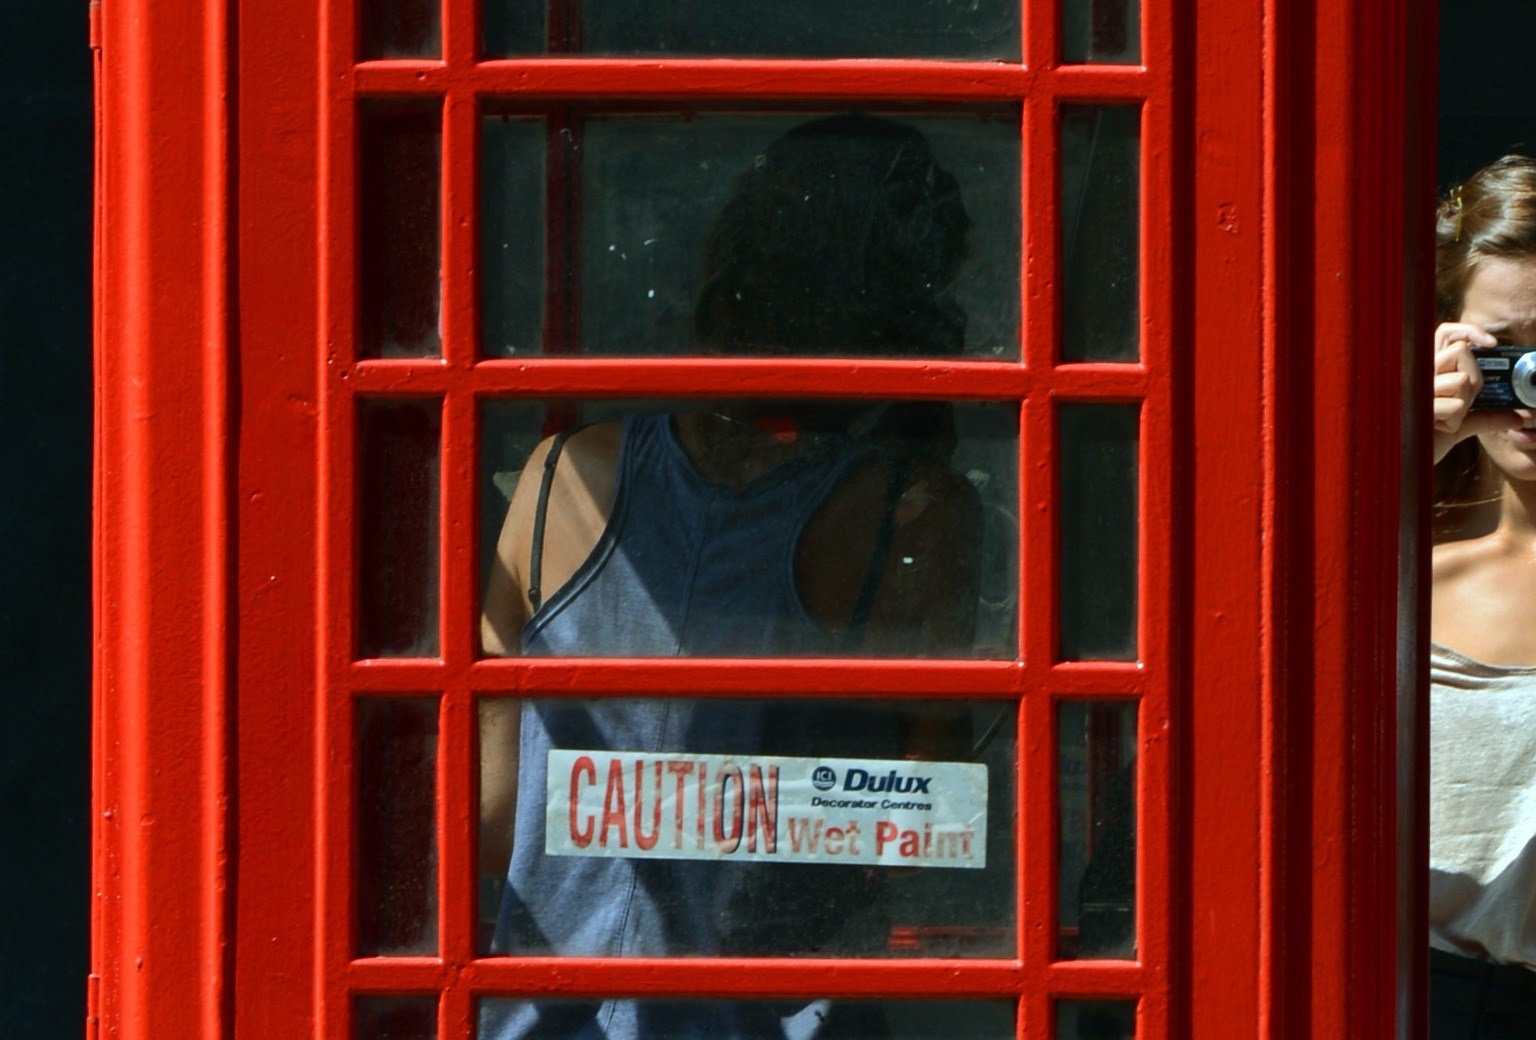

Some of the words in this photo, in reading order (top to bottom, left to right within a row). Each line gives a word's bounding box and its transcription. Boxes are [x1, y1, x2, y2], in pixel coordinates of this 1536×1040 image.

[843, 768, 932, 794] Dulux
[569, 756, 780, 854] CAUTION
[811, 797, 878, 809] Decorator
[881, 799, 932, 811] Centres
[787, 817, 860, 856] Wet
[876, 821, 976, 859] Paint
